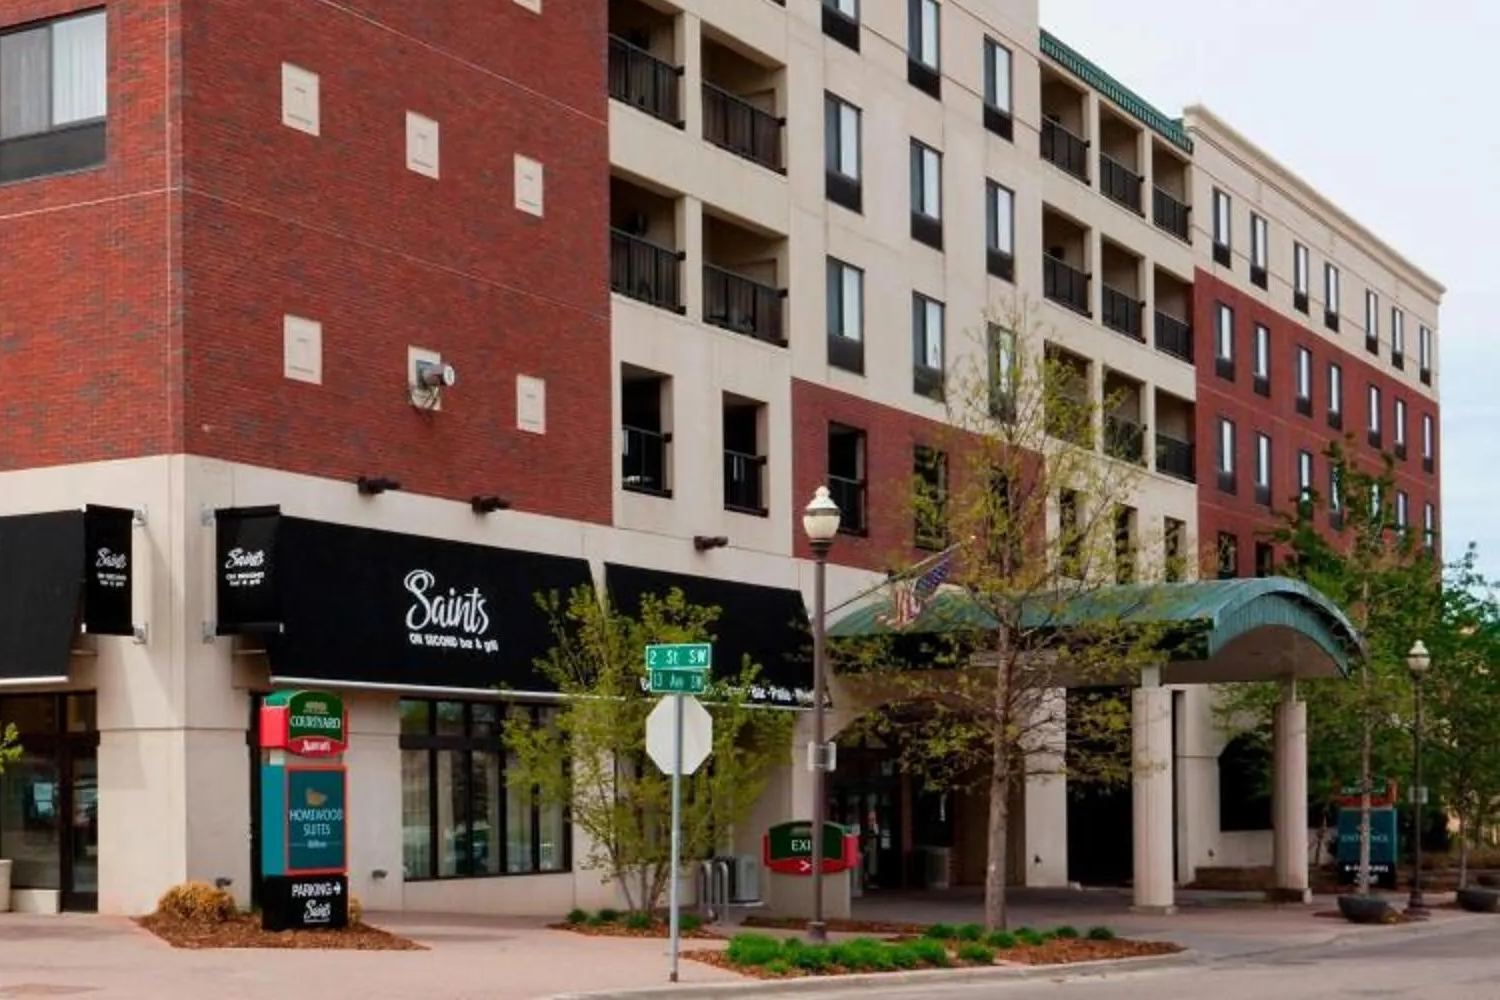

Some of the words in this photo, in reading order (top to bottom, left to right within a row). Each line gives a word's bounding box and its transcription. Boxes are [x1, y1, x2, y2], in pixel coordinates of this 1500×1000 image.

[404, 569, 489, 634] Saints
[649, 650, 657, 665] 2
[666, 649, 678, 665] St
[688, 648, 707, 665] SW
[791, 839, 812, 852] EXI
[291, 883, 333, 897] PARKING
